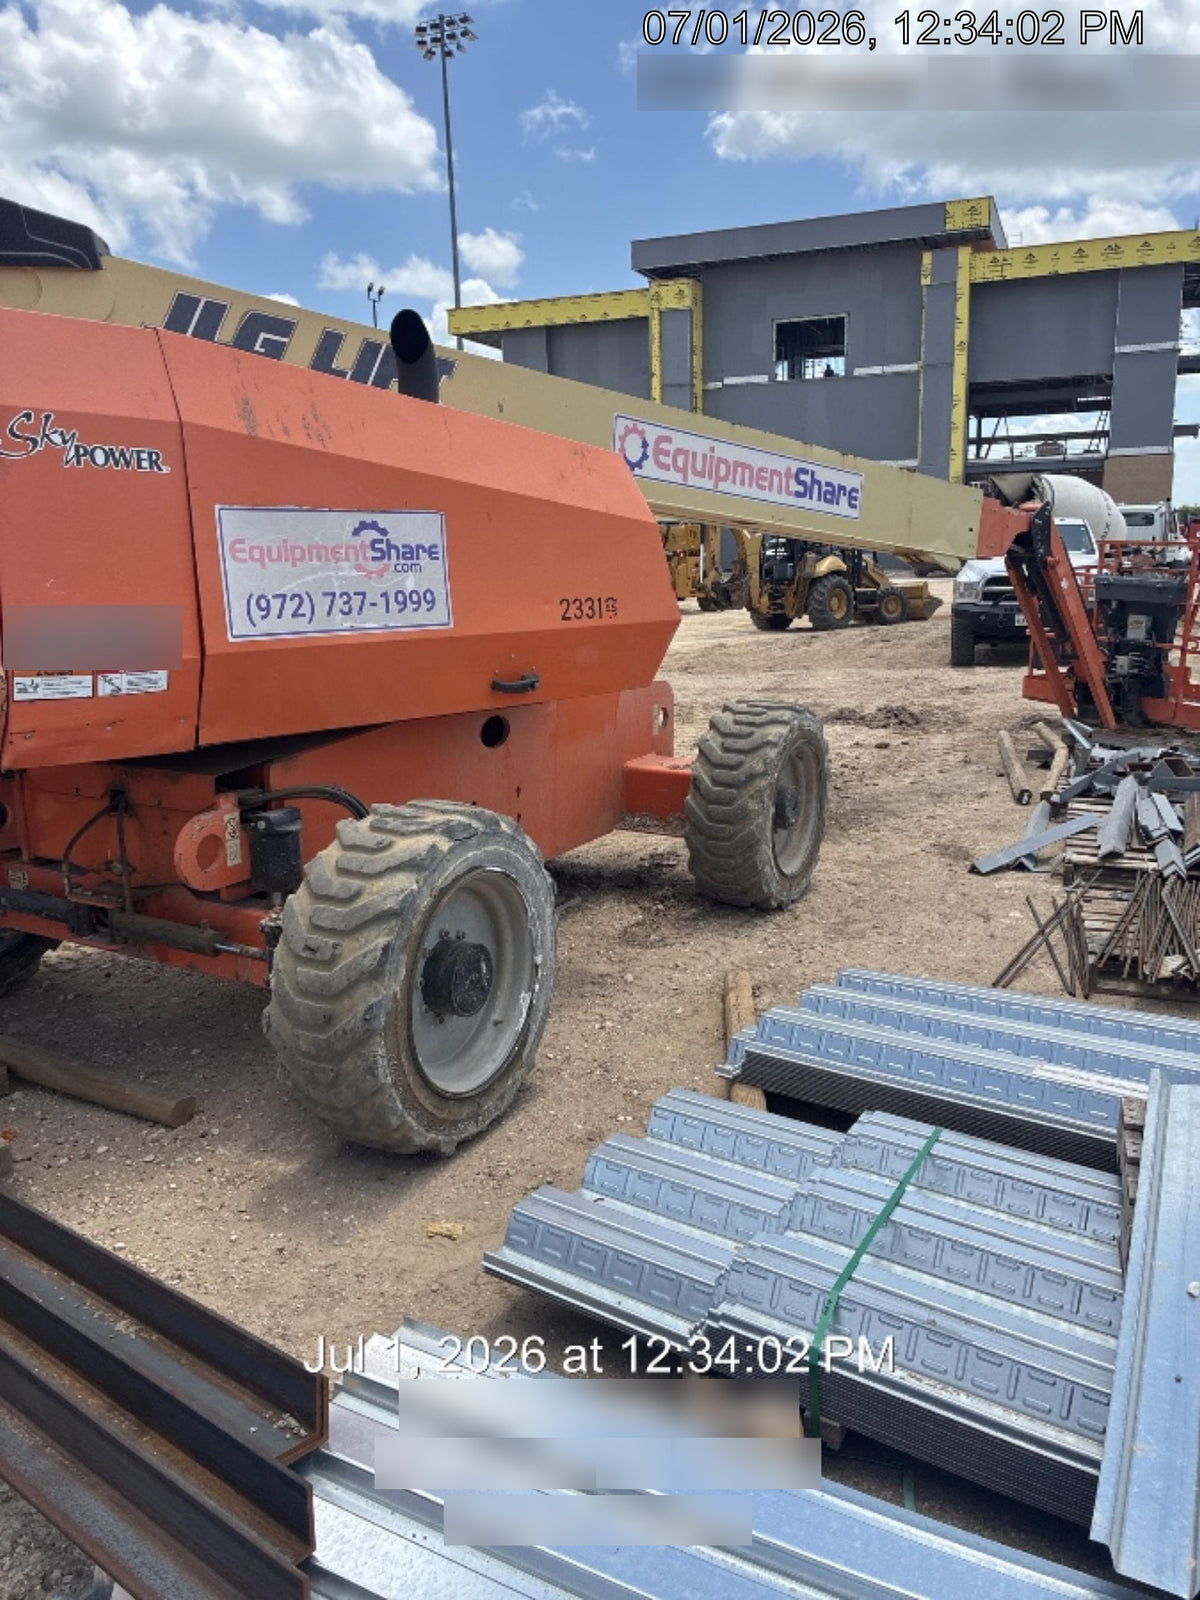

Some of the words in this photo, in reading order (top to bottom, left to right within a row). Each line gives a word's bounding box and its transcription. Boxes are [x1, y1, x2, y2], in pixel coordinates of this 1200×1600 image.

[652, 434, 861, 510] EquipmentShare
[228, 537, 440, 569] EquipmentShare
[391, 562, 422, 573] .com
[246, 591, 316, 628] (972)
[322, 588, 436, 619] 737-1999
